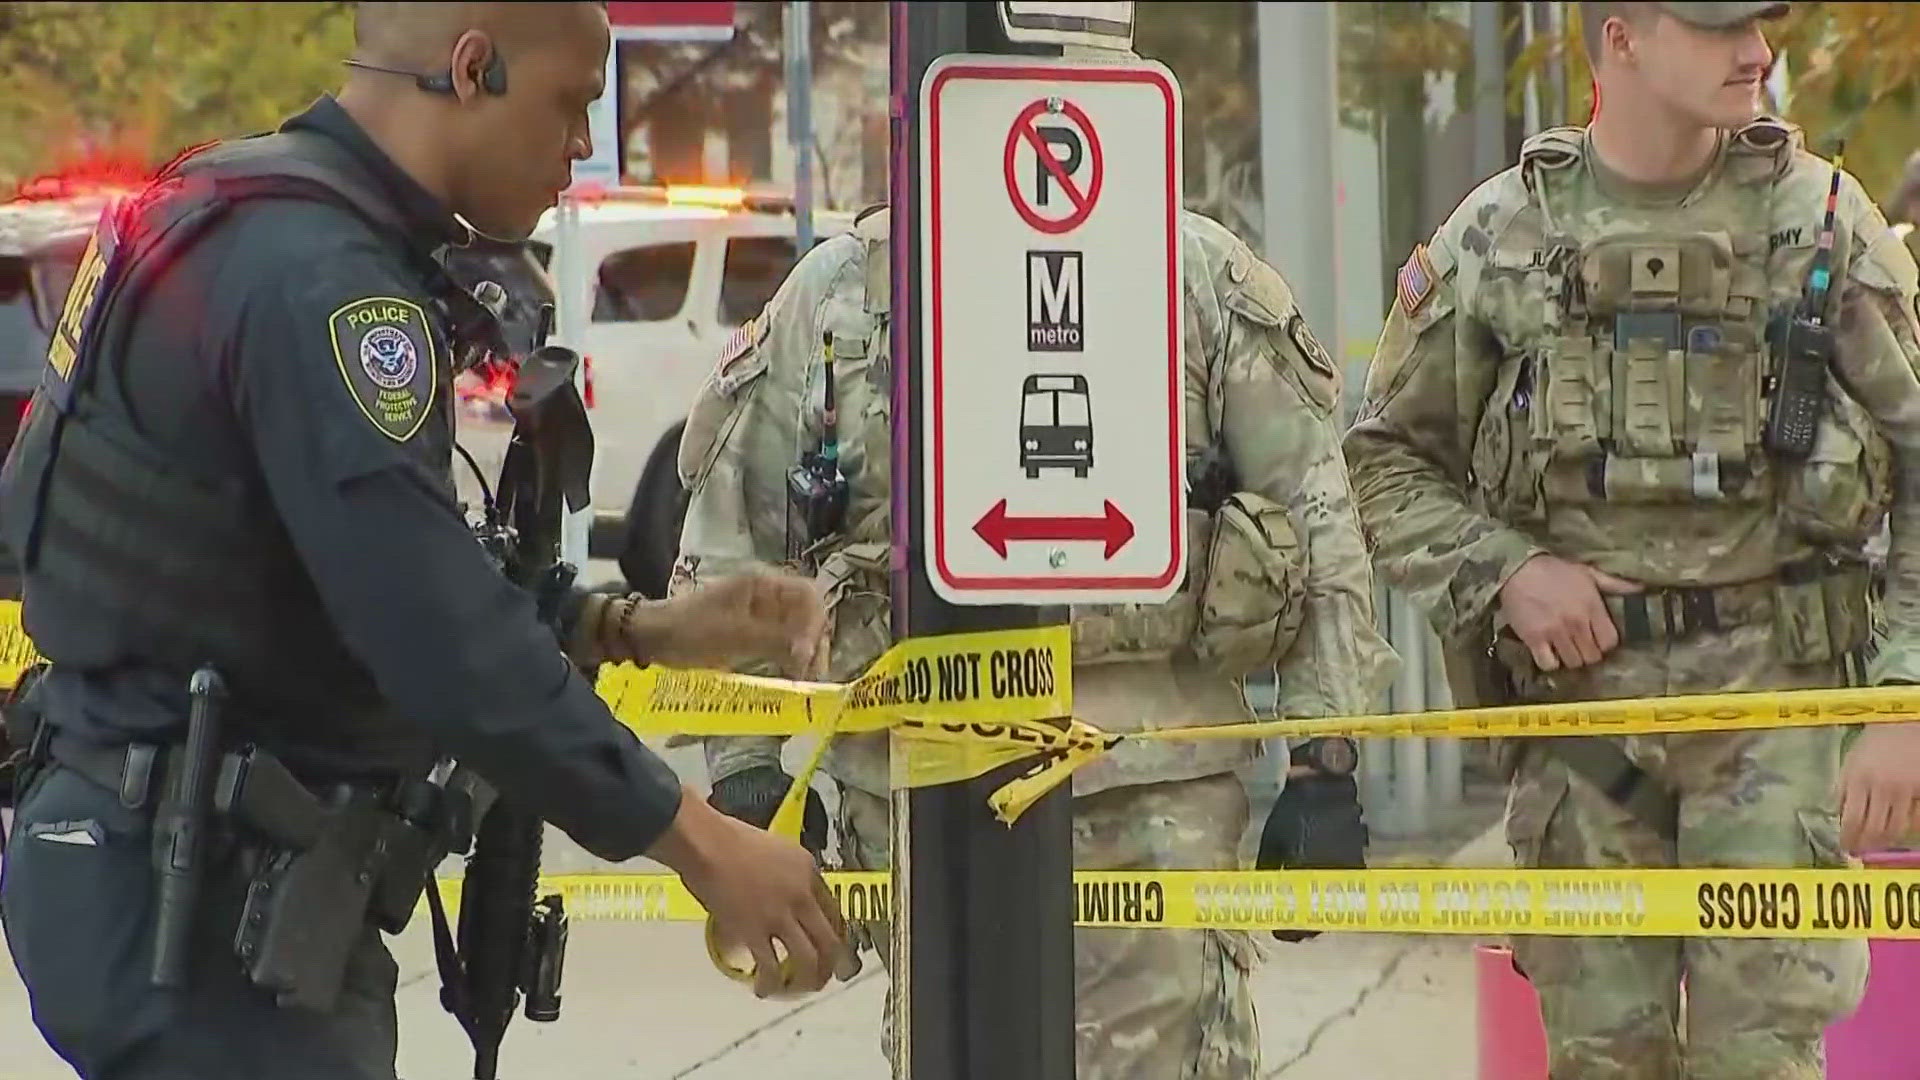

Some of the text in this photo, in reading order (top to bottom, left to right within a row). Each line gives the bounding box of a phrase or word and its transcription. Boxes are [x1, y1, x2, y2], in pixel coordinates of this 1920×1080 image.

[1036, 127, 1082, 206] P
[1769, 226, 1802, 252] RMY
[1030, 256, 1079, 324] M
[346, 306, 410, 330] POLICE
[1030, 325, 1080, 344] metro
[374, 396, 418, 411] PROTECTIVE
[378, 388, 412, 400] FEDERAL
[384, 409, 414, 422] SERVICE
[904, 656, 932, 704] DO
[937, 652, 982, 702] NOT
[990, 646, 1055, 699] CROSS
[1074, 880, 1164, 923] CRIM
[1697, 881, 1920, 931] DO NOT CROSS
